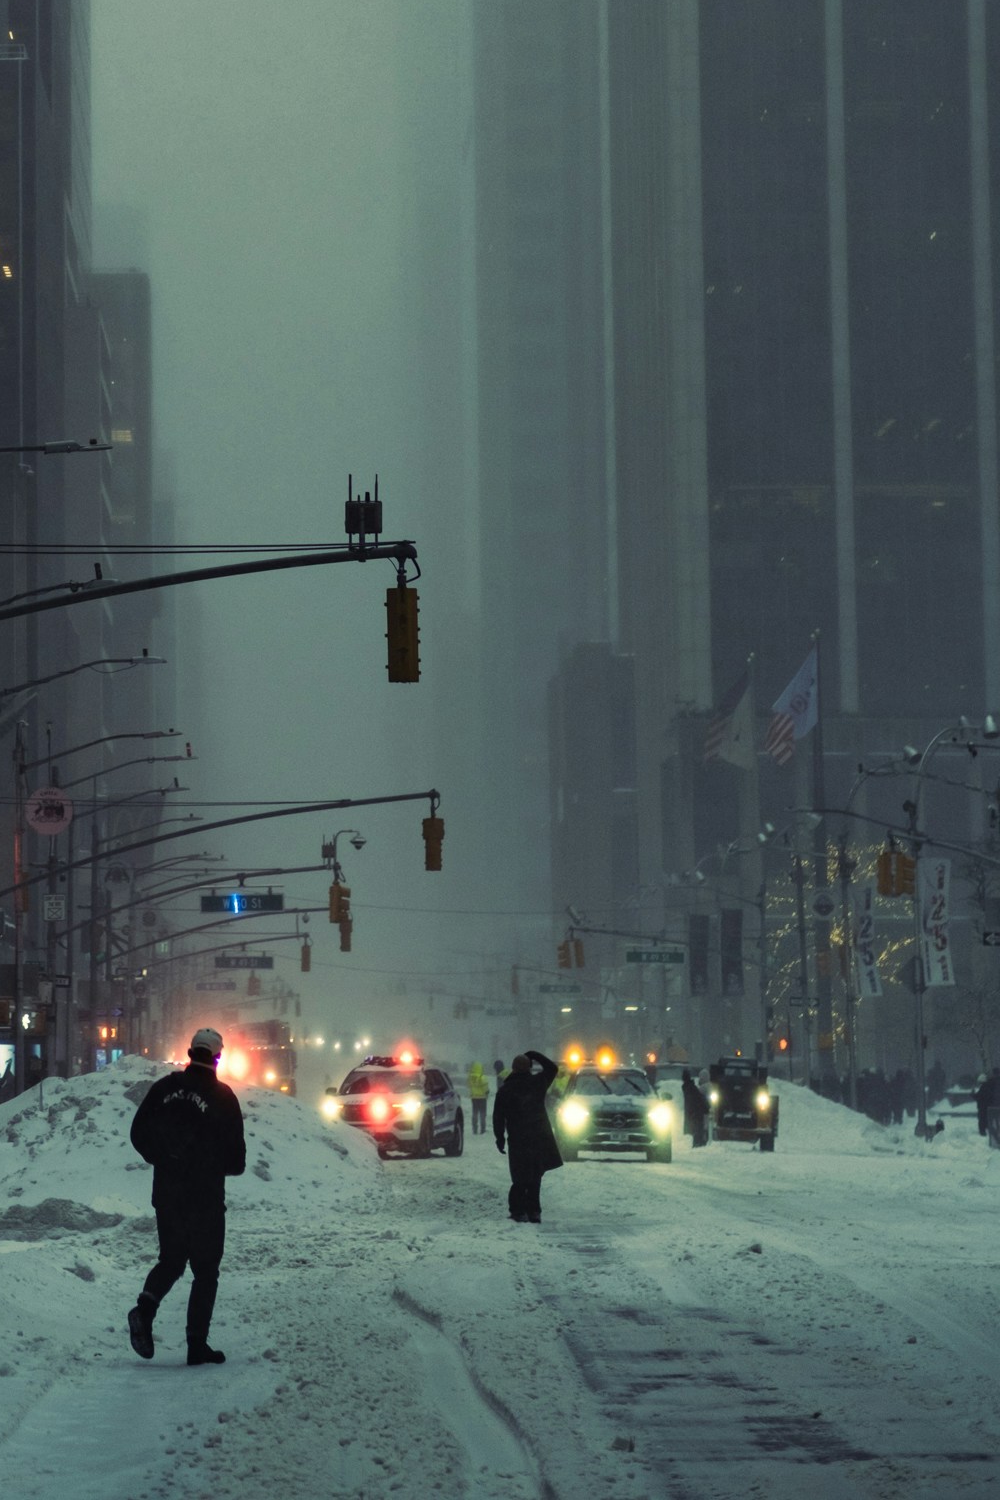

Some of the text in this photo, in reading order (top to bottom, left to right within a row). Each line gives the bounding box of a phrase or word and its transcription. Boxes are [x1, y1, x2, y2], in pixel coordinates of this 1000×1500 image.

[222, 898, 263, 909] W 0 St
